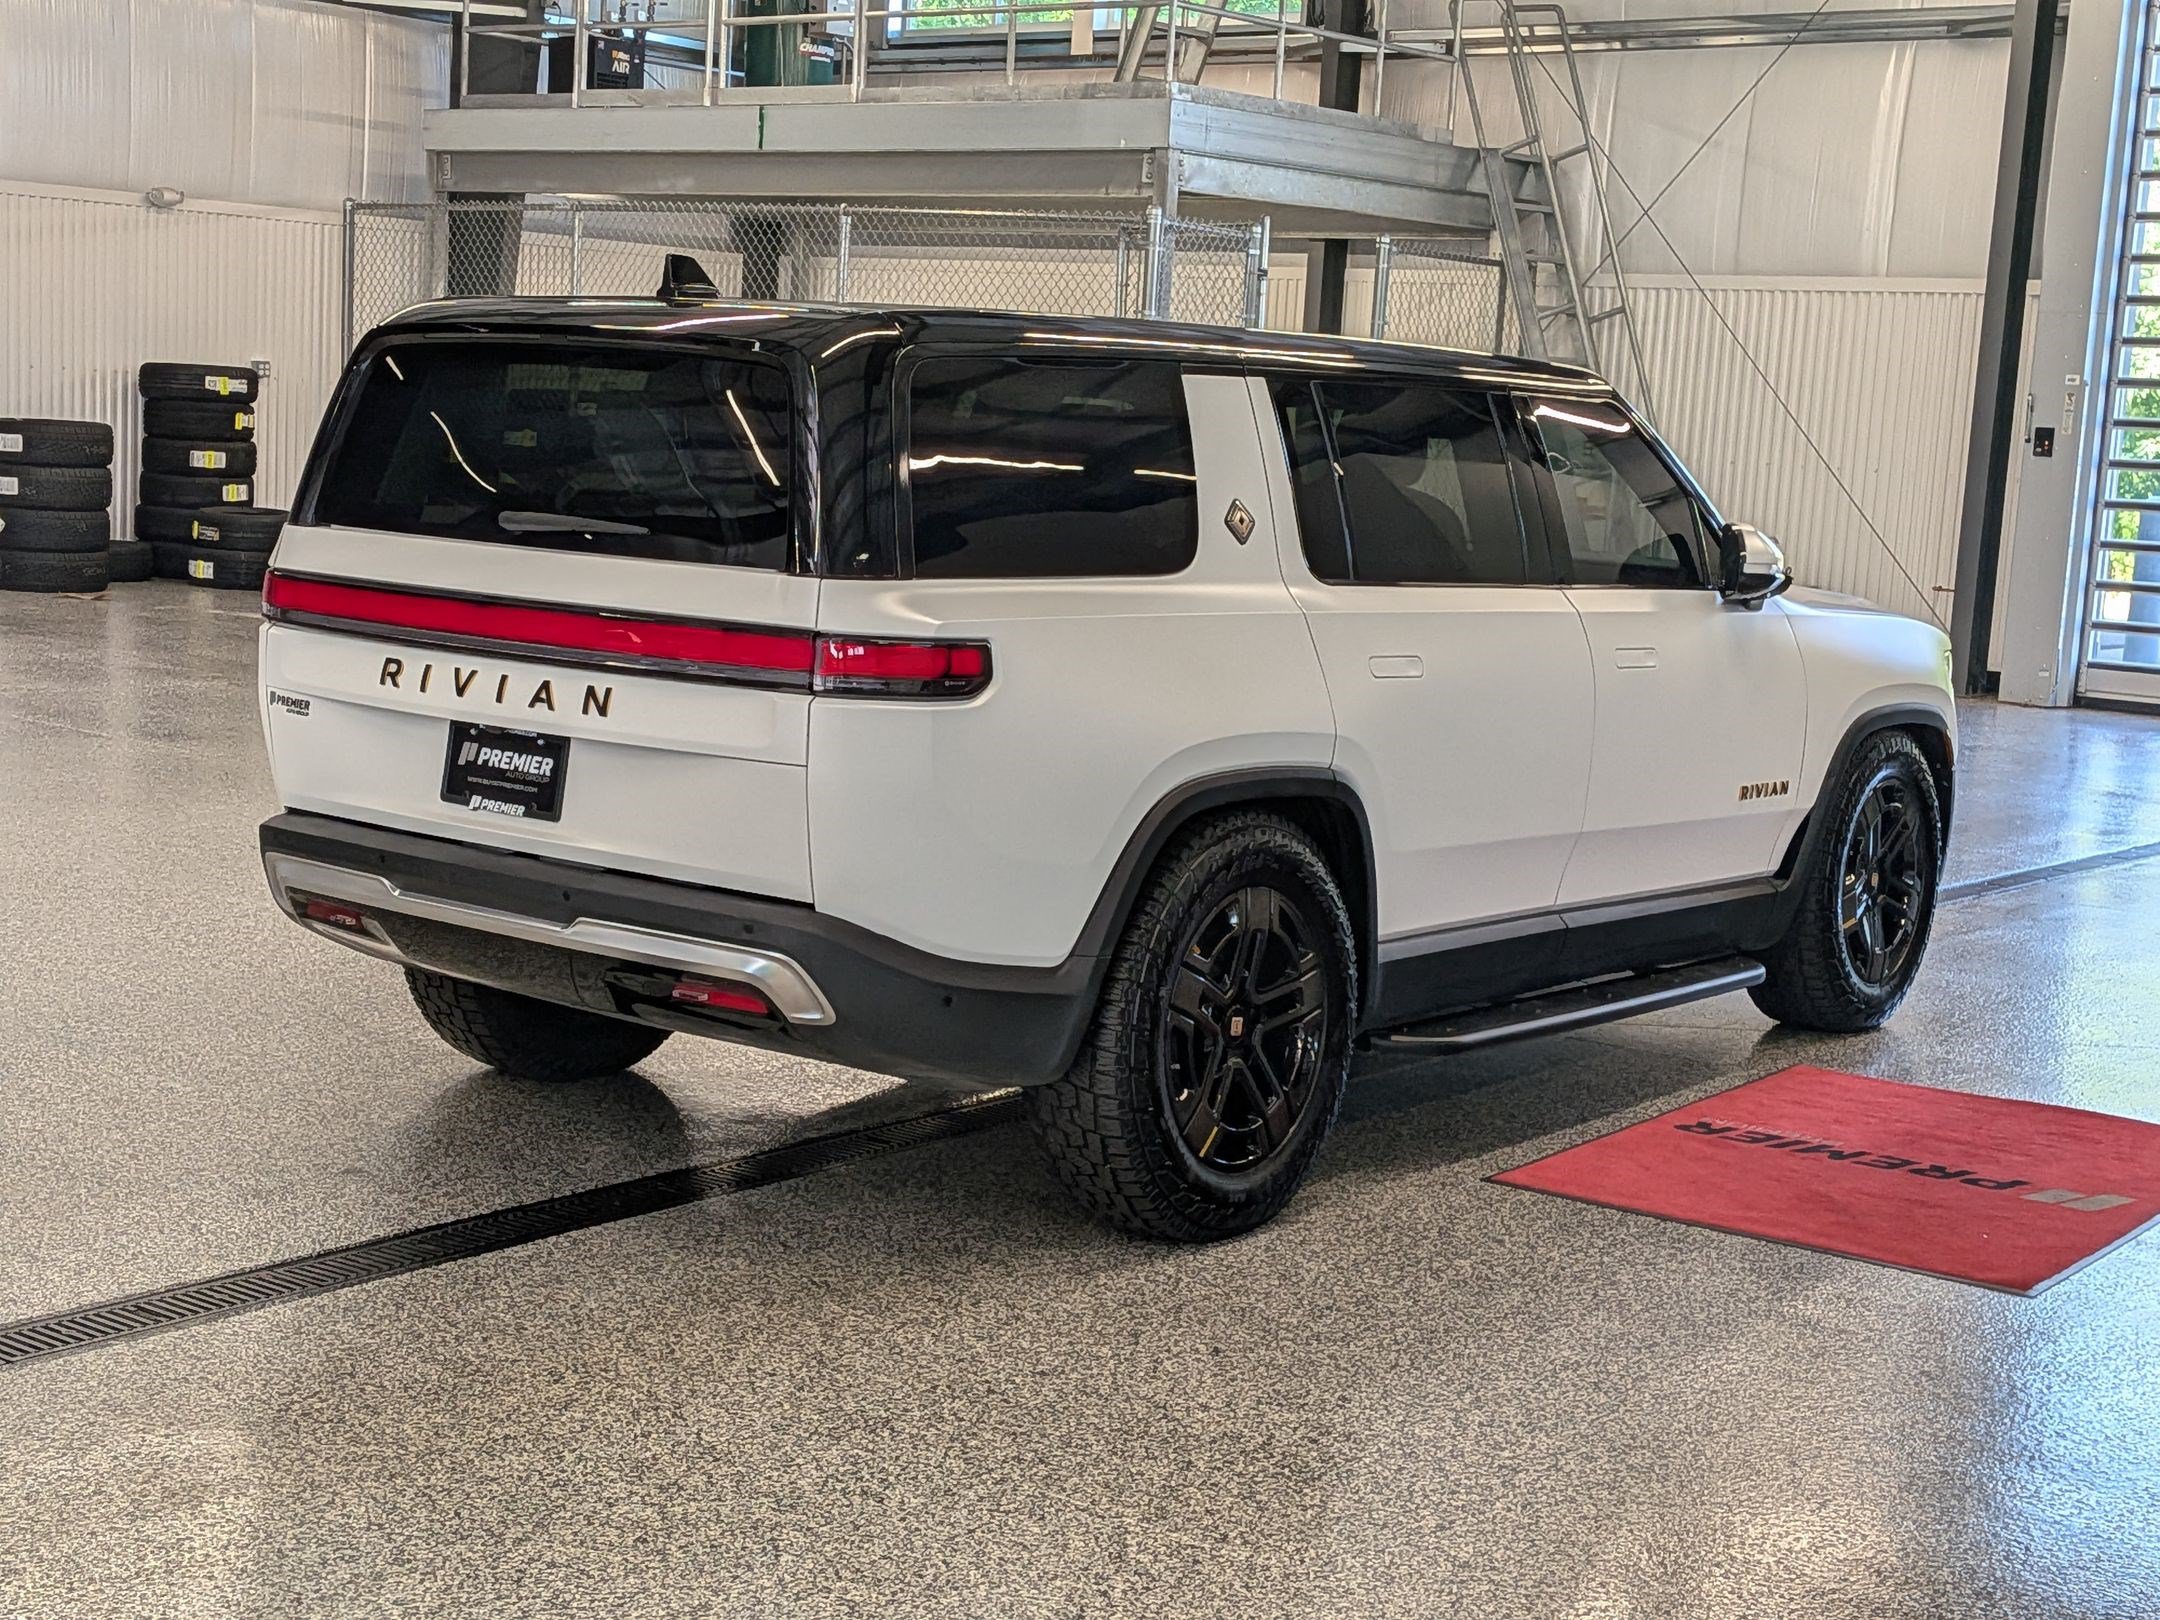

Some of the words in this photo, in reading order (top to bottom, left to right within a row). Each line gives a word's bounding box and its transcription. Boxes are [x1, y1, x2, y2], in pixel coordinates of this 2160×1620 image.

[612, 60, 630, 74] AIR
[379, 657, 613, 717] RIVIAN
[276, 694, 311, 711] PREMIER
[477, 747, 554, 776] PREMIER
[505, 771, 524, 780] AUTO
[524, 774, 551, 784] GROUP
[1738, 780, 1790, 801] RIVIAN
[480, 798, 526, 817] PREMIER
[1673, 1121, 2032, 1191] PREMIER
